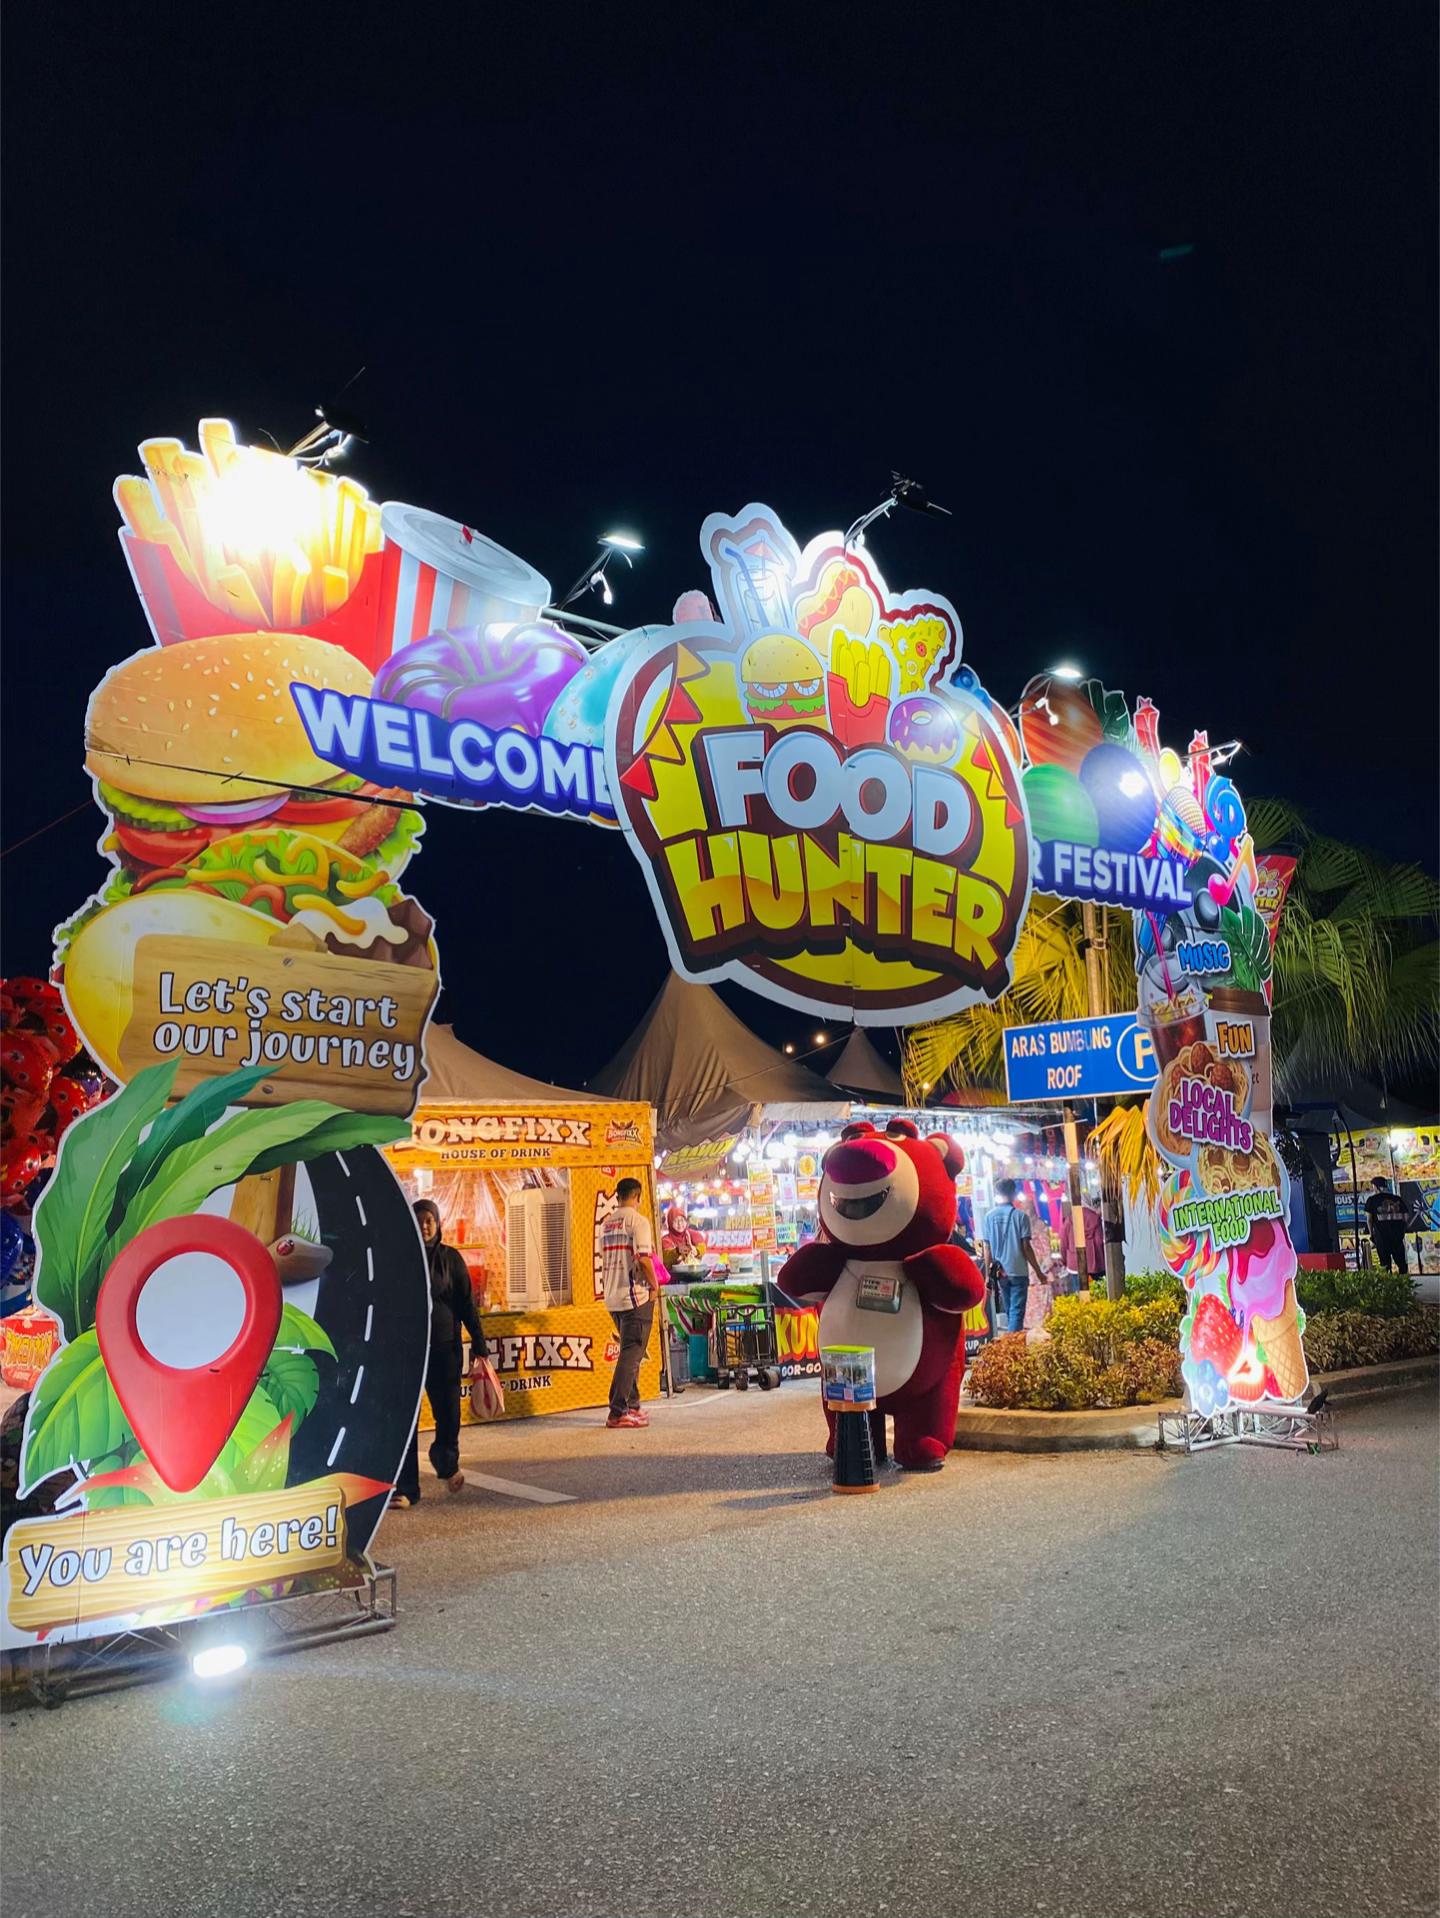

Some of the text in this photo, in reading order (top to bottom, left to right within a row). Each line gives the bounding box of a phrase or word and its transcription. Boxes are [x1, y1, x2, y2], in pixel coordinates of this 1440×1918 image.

[702, 730, 971, 855] FOOD
[1054, 842, 1192, 902] FESTIVAL
[664, 830, 1006, 970] HUNTER
[1177, 941, 1230, 974] MUSIC
[160, 972, 398, 1028] Let's start
[154, 1020, 416, 1081] our journey
[1011, 1033, 1046, 1058] ARAS
[1216, 1021, 1253, 1054] FUN
[1047, 1065, 1082, 1090] ROOF
[1182, 1080, 1234, 1114] LOCAL
[1170, 1102, 1252, 1151] DELIGHTS
[441, 1147, 551, 1160] HOUSE OF DRINK
[1173, 1190, 1281, 1231] INTERNATIONAL
[707, 1230, 752, 1247] DESSER
[1211, 1218, 1248, 1247] FOOD
[510, 1376, 552, 1391] DRINK
[19, 1505, 339, 1596] You are here!
